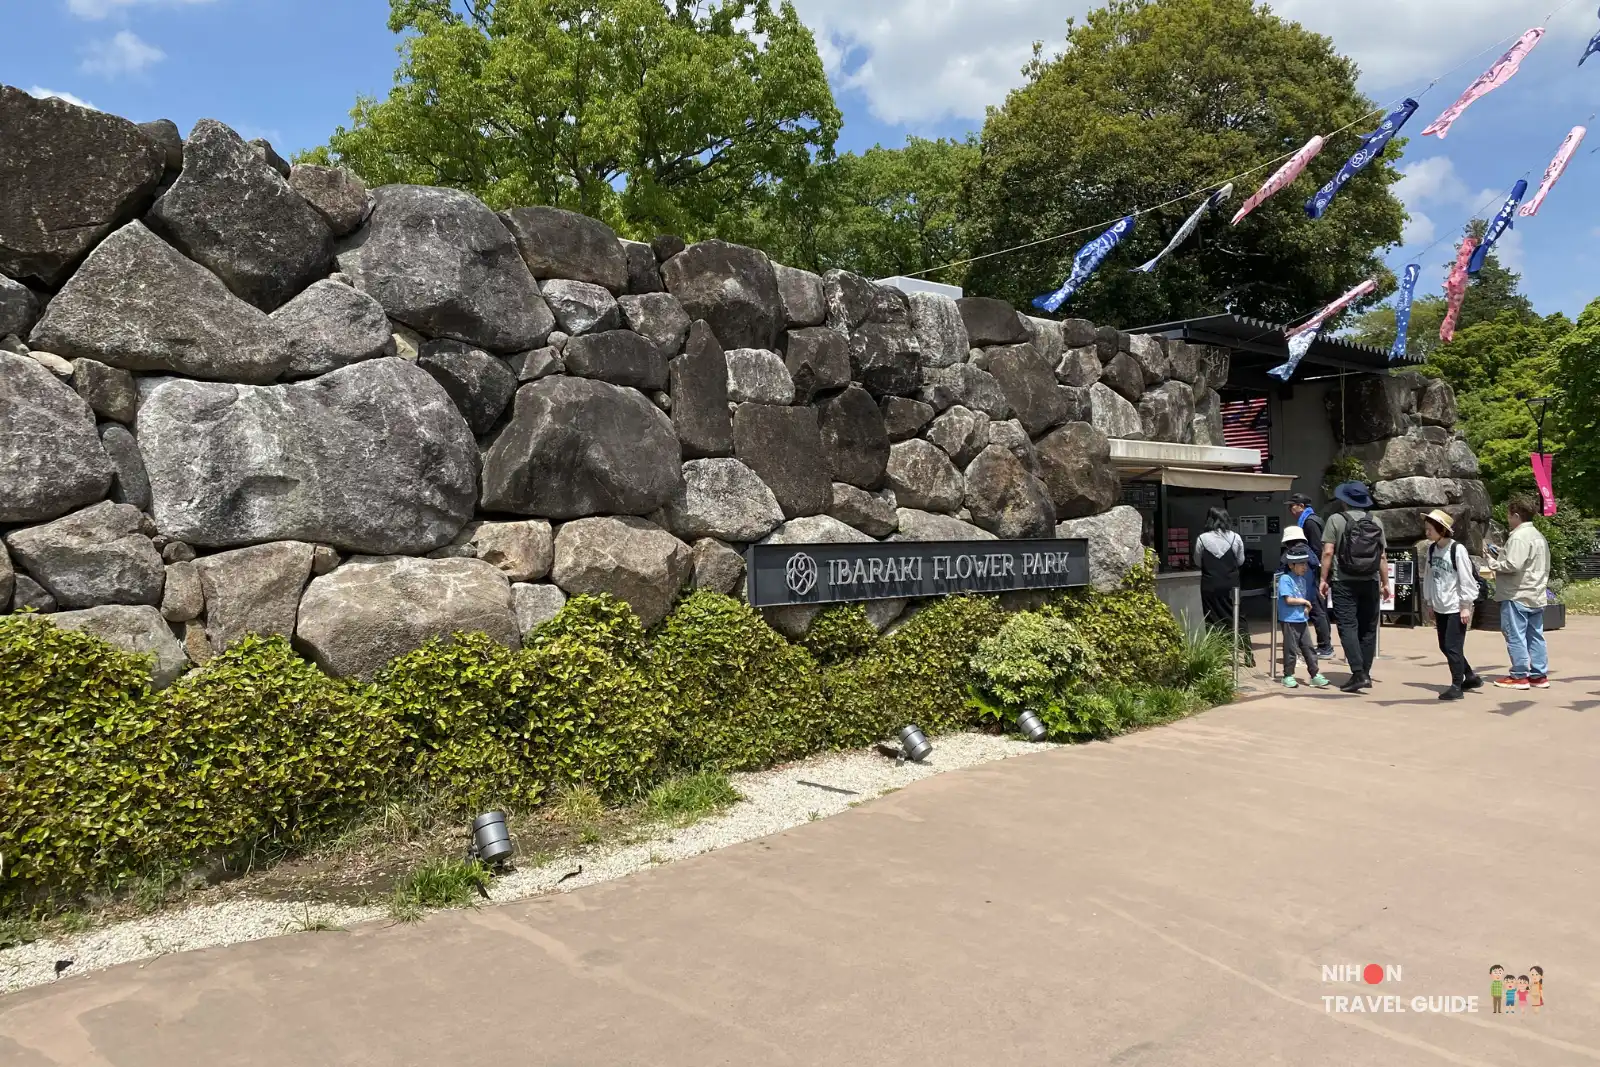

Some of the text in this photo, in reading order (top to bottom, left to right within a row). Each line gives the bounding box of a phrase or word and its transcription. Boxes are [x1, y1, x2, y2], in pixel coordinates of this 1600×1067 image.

[827, 552, 1070, 585] IBARAKI FLOWER PARK
